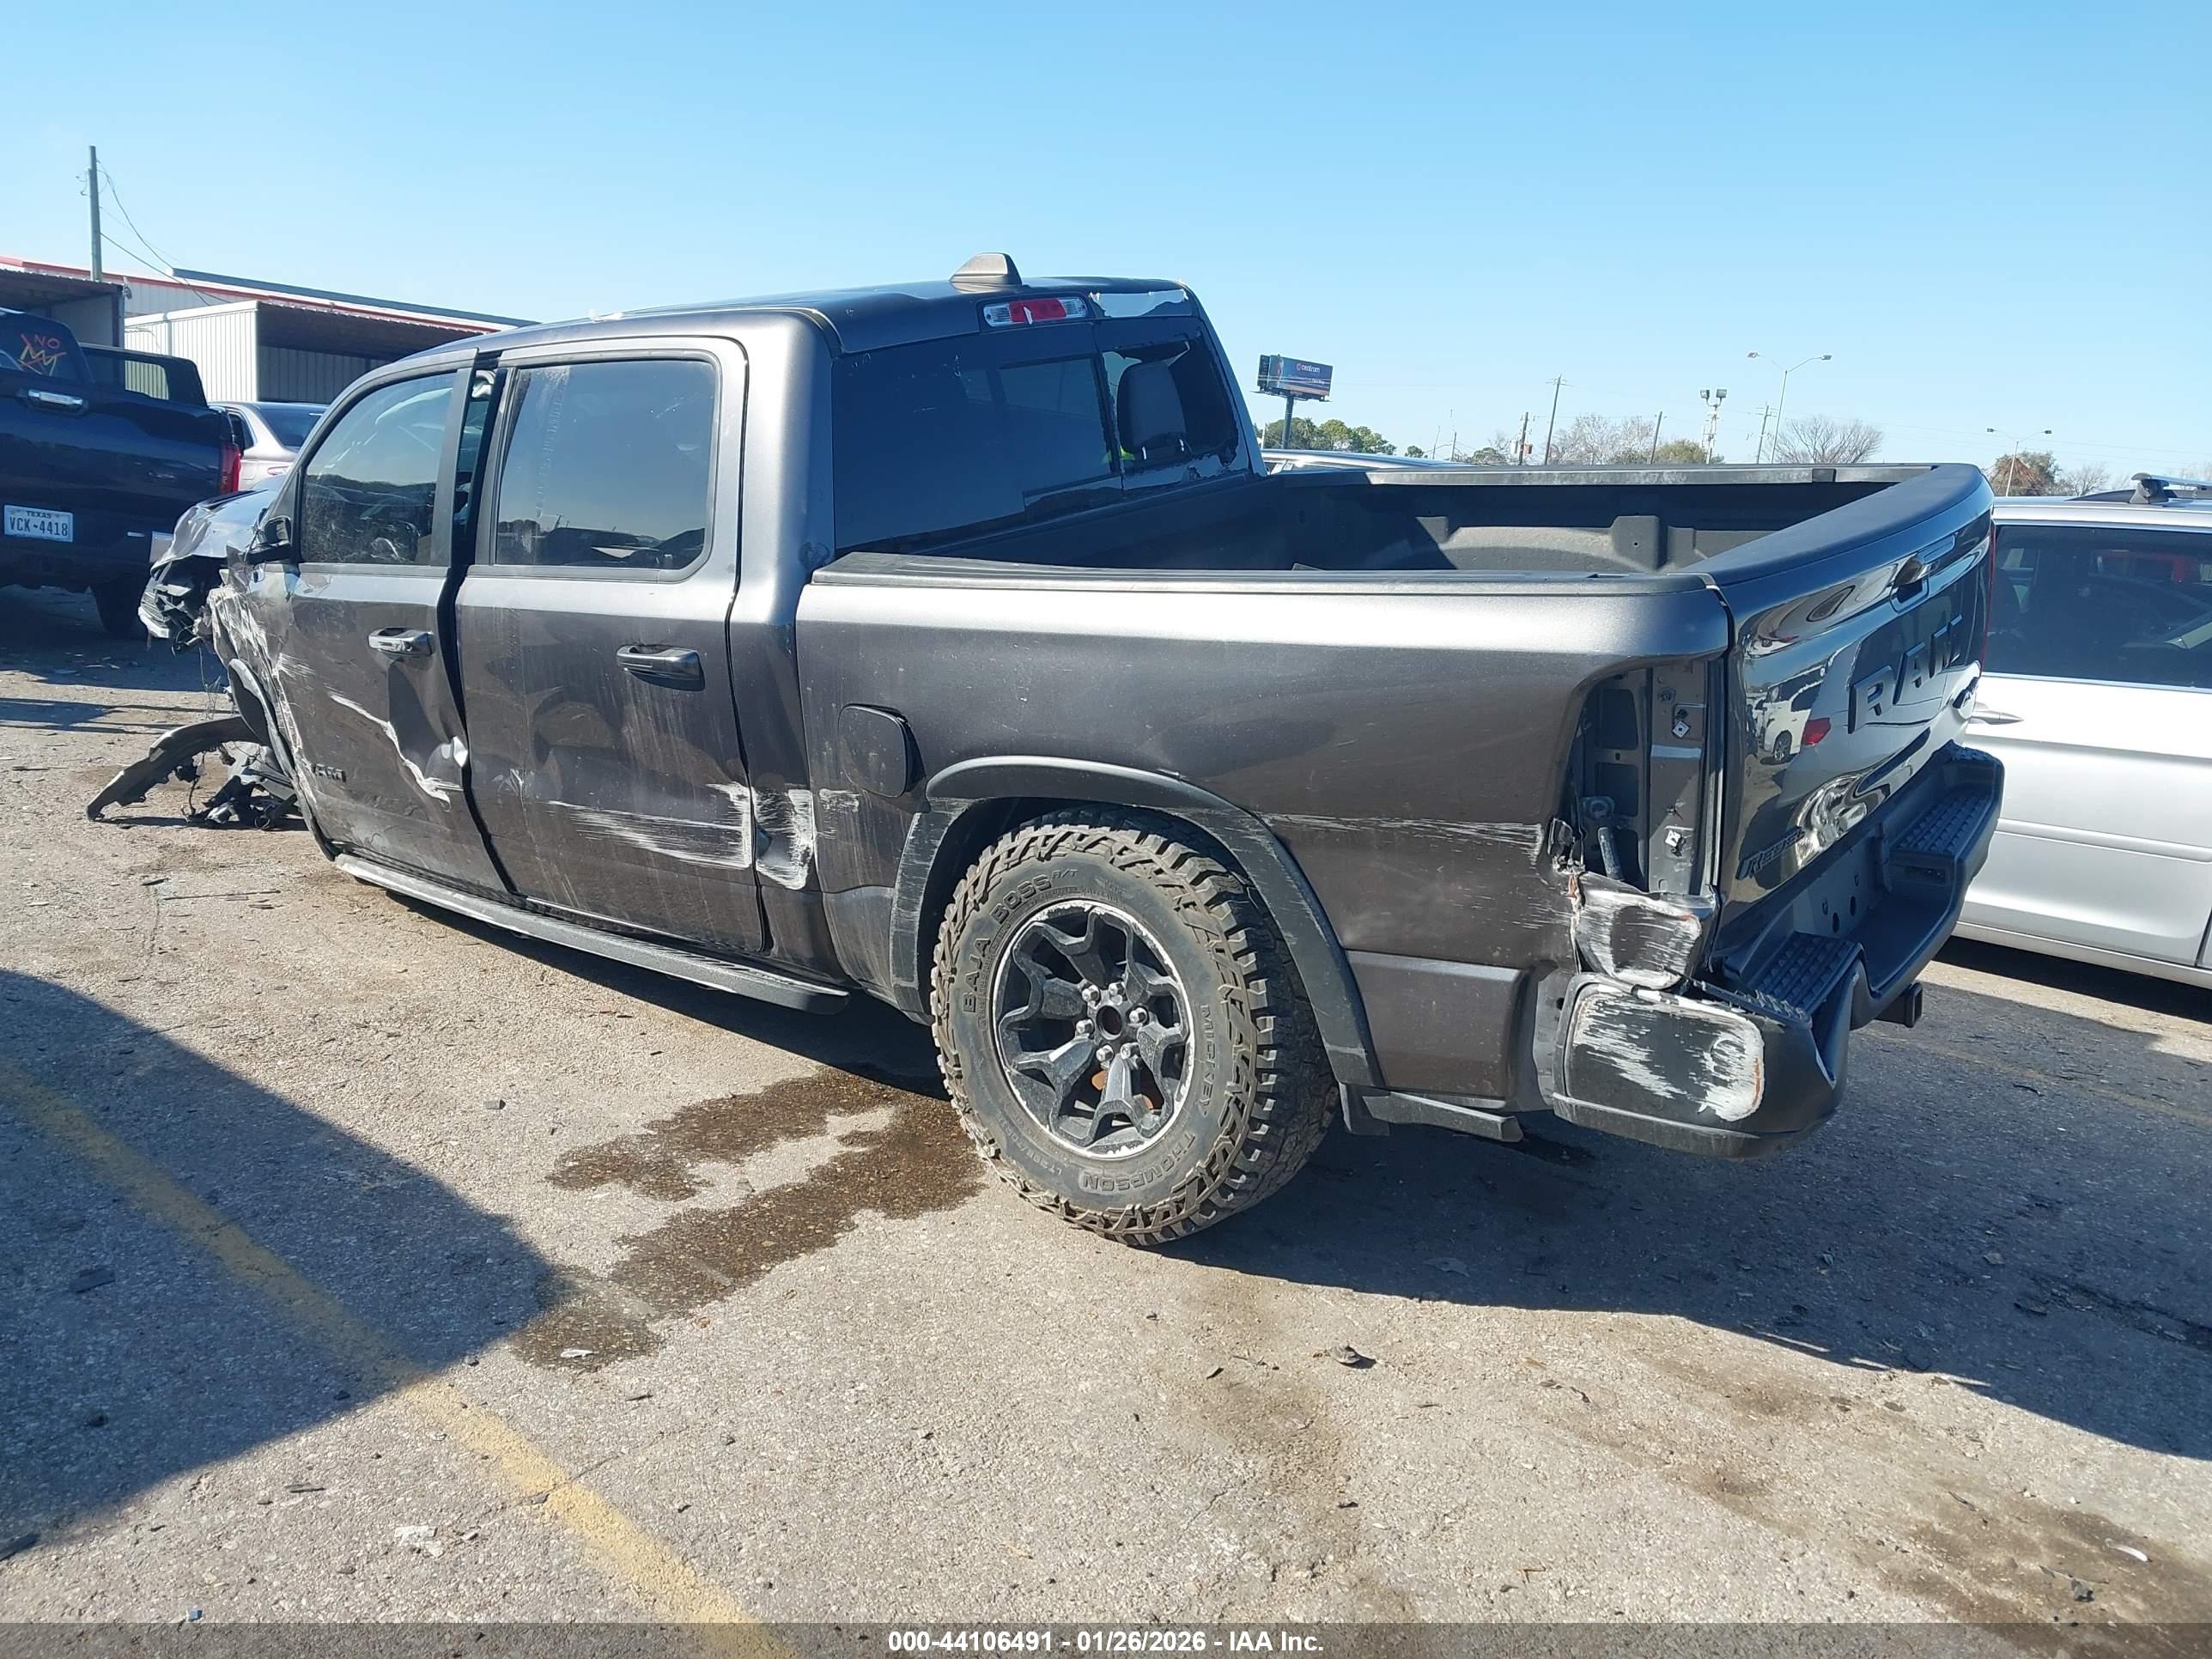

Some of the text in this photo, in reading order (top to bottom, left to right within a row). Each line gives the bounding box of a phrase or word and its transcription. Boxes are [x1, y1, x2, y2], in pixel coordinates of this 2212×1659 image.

[27, 510, 52, 519] TEXAS
[1848, 613, 1963, 735] RAM
[963, 937, 992, 1013] BAJA
[989, 873, 1052, 924] BOSS
[1083, 1132, 1196, 1193] THOMPSON
